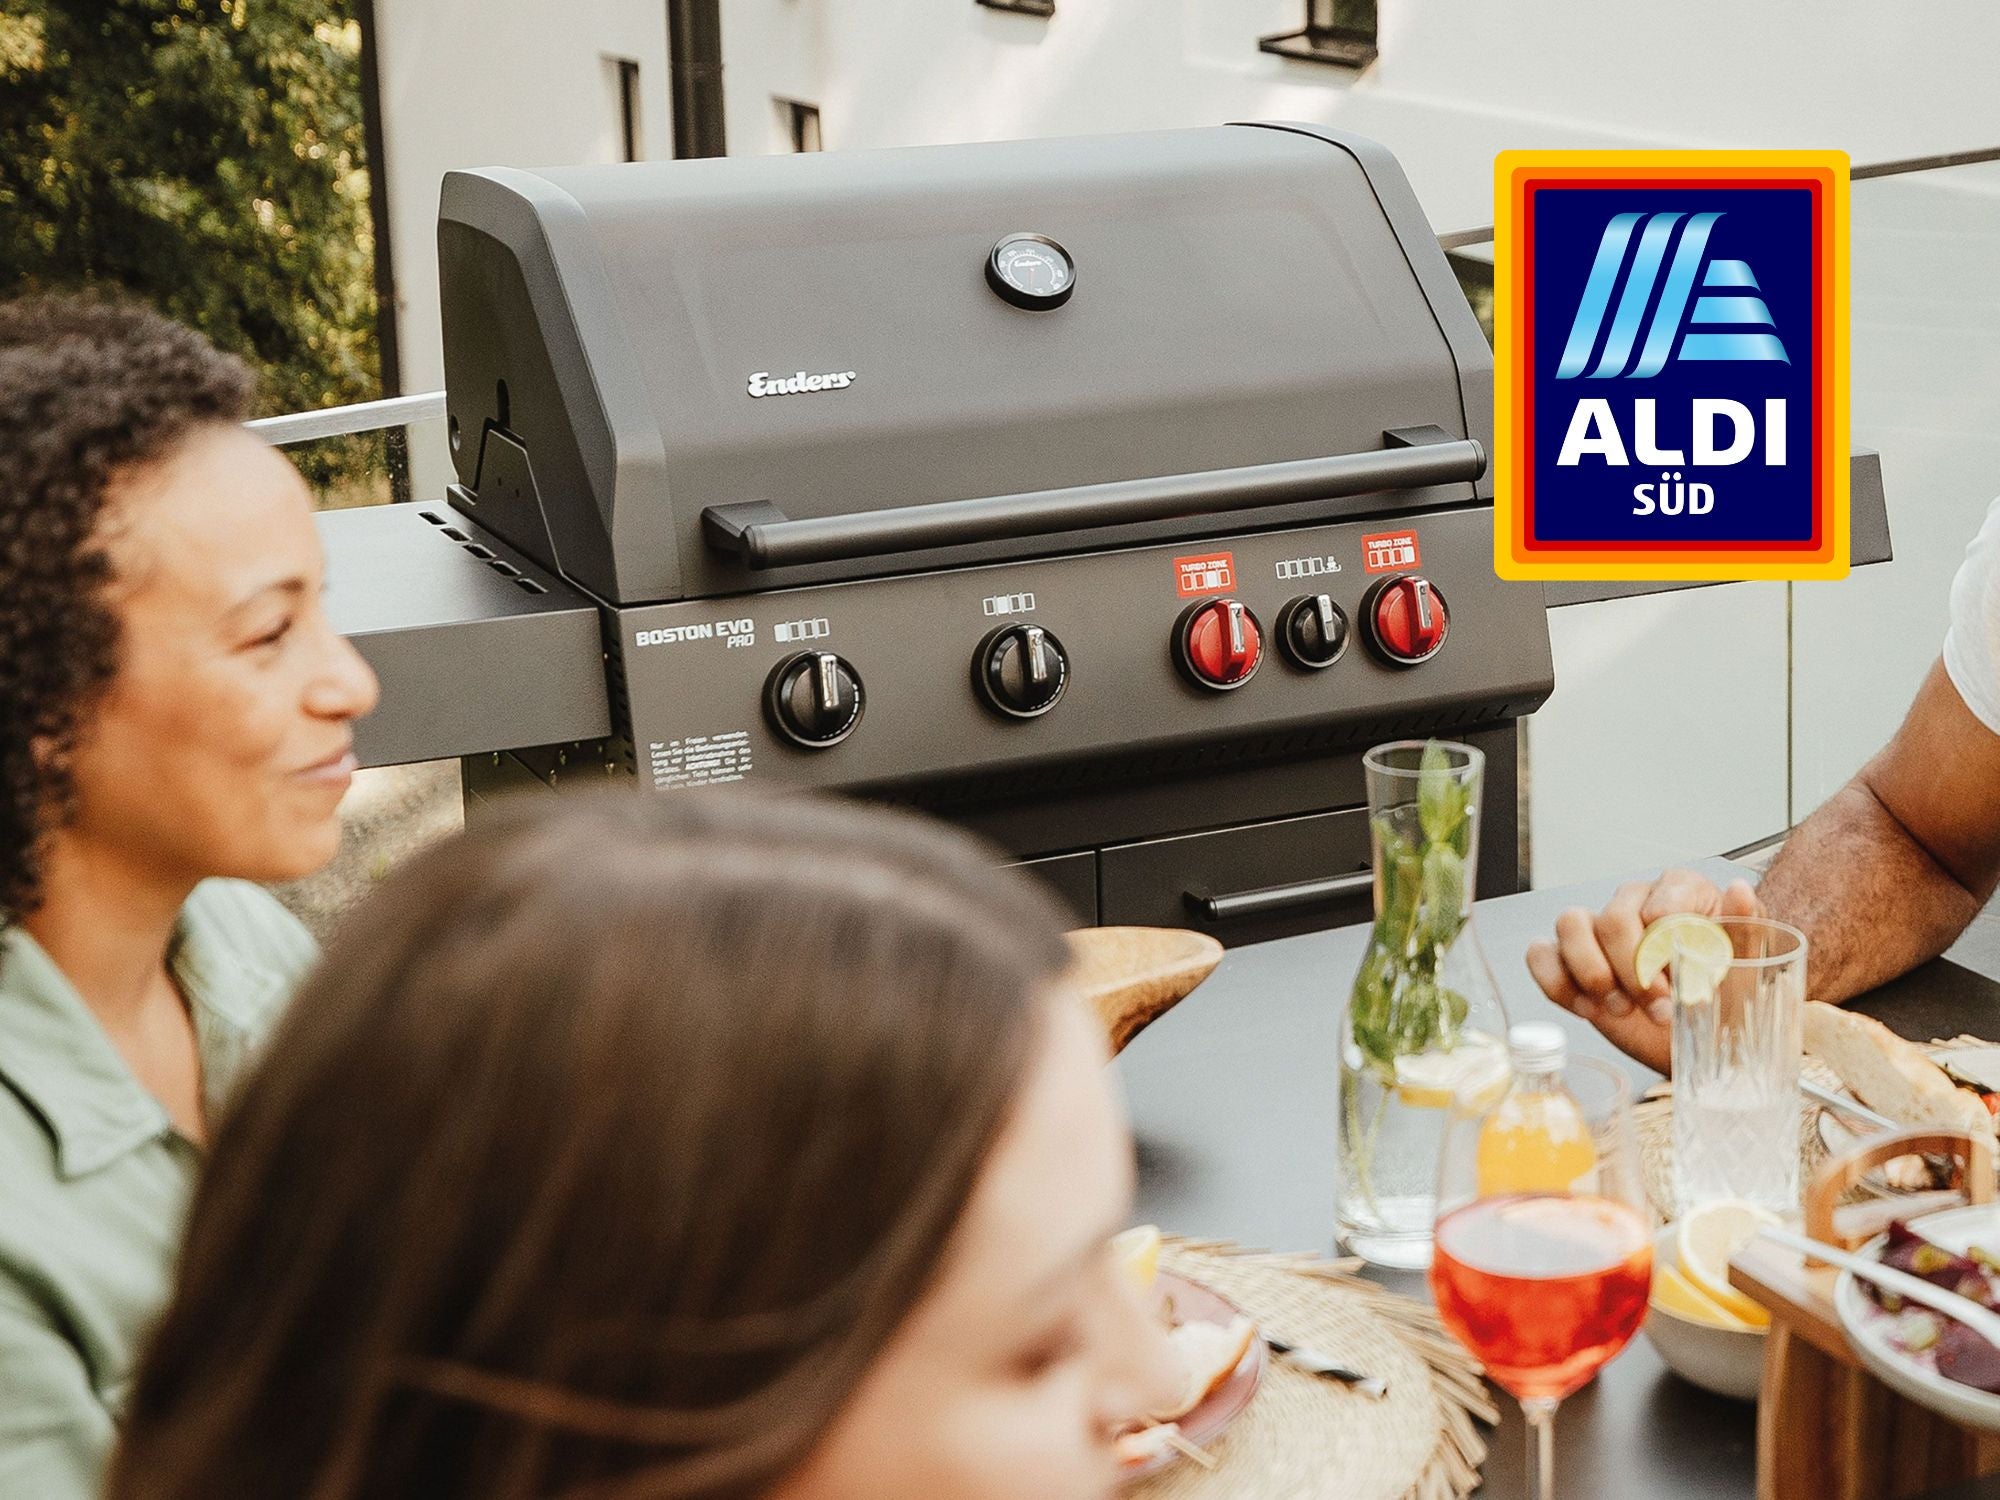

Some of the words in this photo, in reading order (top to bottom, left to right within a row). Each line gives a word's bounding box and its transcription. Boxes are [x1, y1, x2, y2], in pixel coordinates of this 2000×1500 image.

[747, 371, 856, 398] Enders
[1367, 539, 1392, 549] TURBO
[1392, 536, 1412, 546] ZONE
[1180, 562, 1207, 572] TURBO
[1207, 559, 1228, 569] ZONE
[635, 623, 713, 647] BOSTON
[715, 618, 755, 637] EVO
[726, 633, 755, 649] PRO
